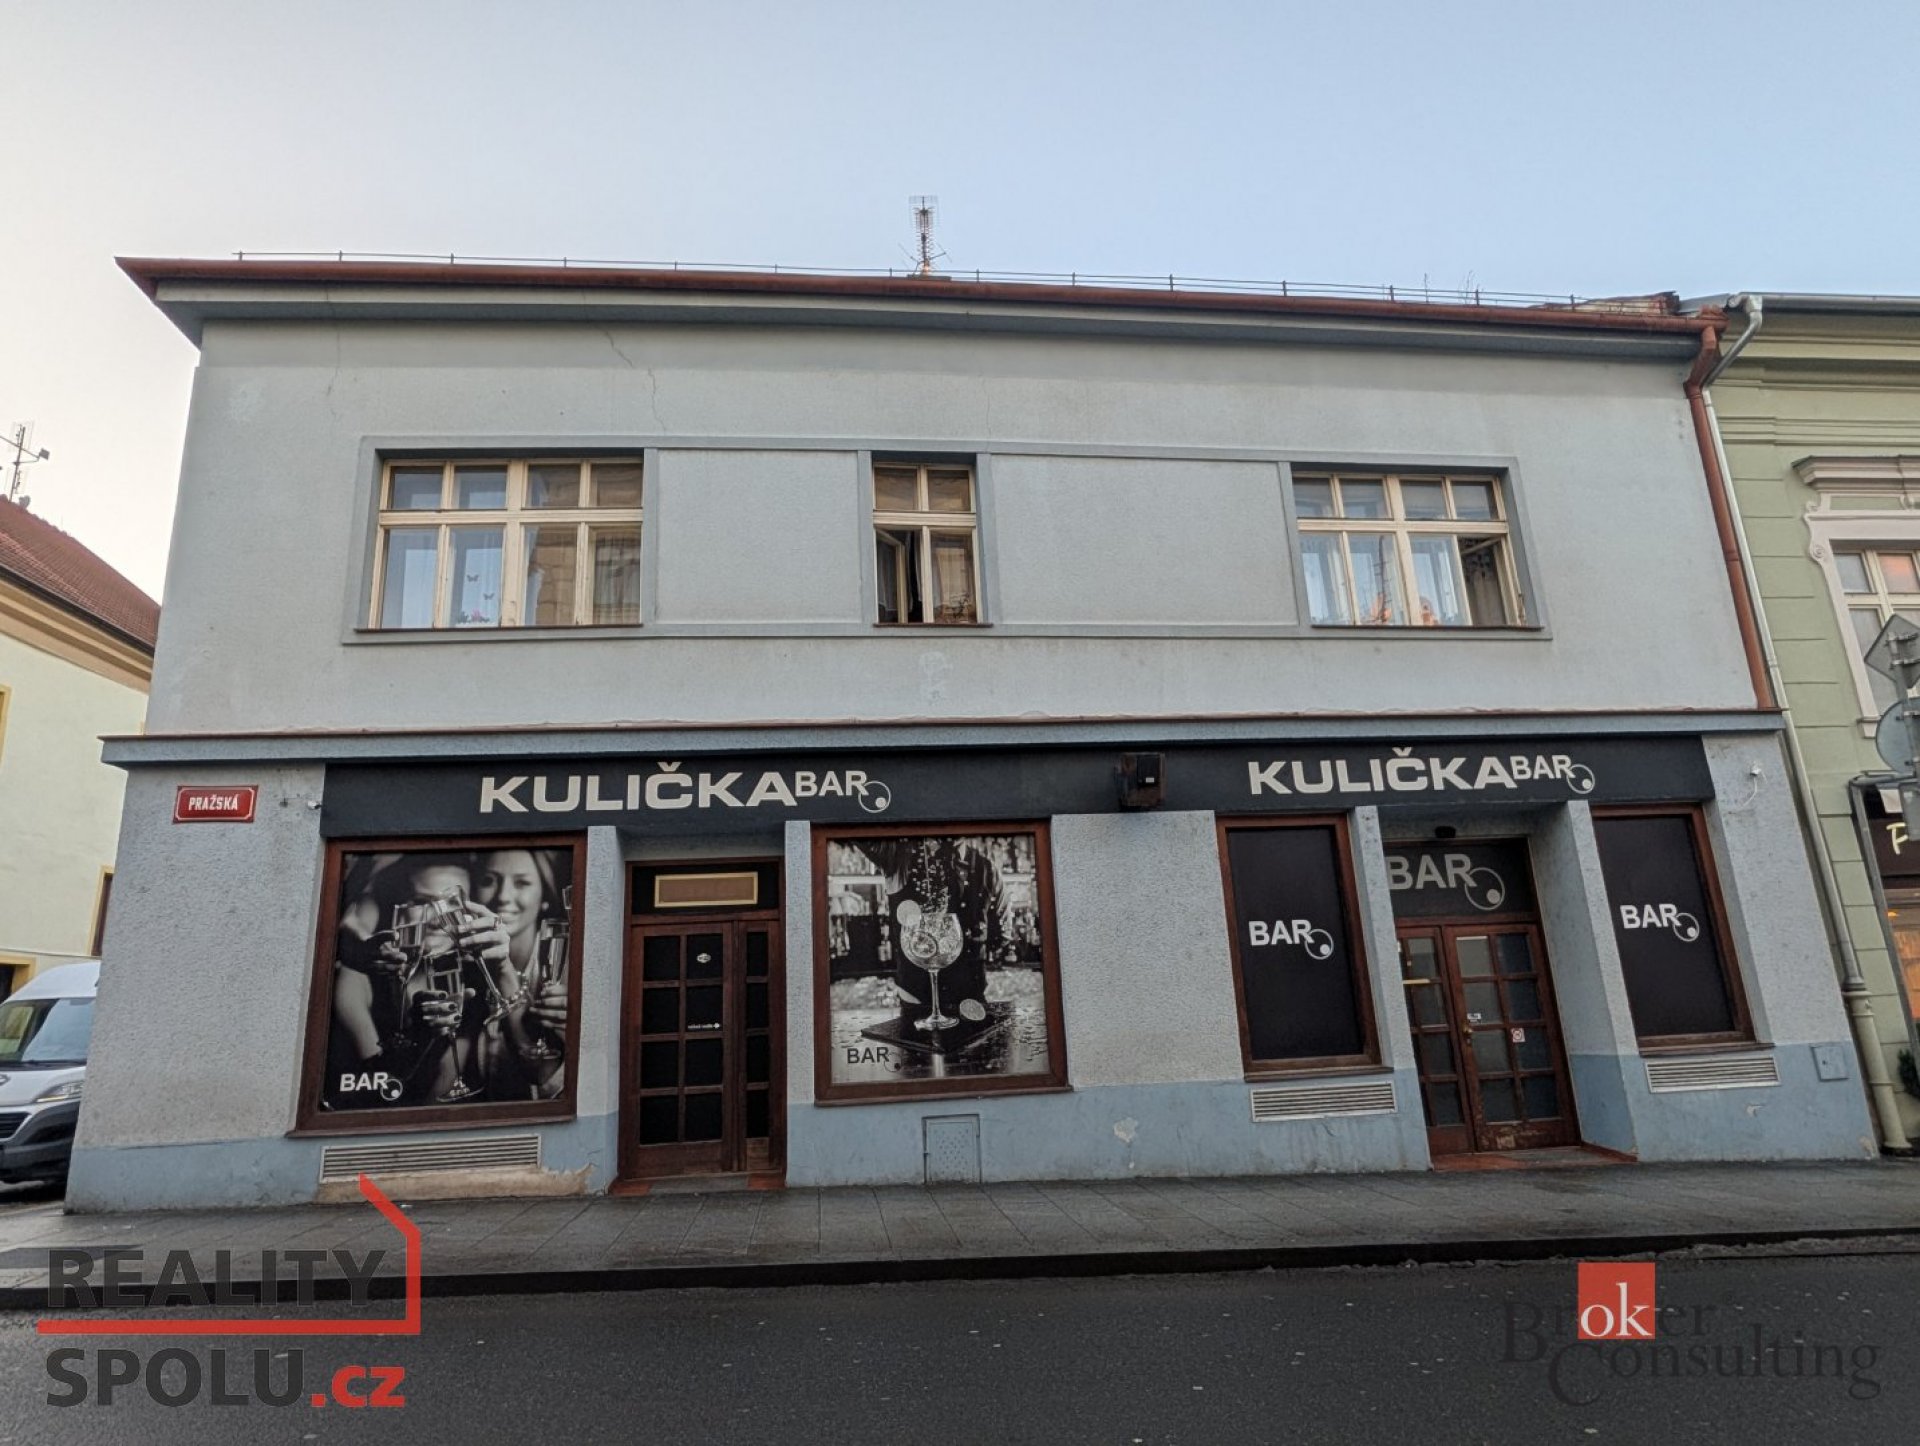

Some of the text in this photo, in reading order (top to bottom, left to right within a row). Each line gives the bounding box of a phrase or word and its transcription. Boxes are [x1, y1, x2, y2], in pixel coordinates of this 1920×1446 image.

[1248, 747, 1575, 795] KULIČKA BAR
[479, 762, 869, 813] KULIČKA BAR
[188, 793, 240, 811] PRAŽSKÁ
[1384, 853, 1478, 890] BAR
[1620, 903, 1682, 929] BAR
[1248, 919, 1315, 946] BAR
[847, 1046, 890, 1064] BAR
[340, 1071, 389, 1092] BAR
